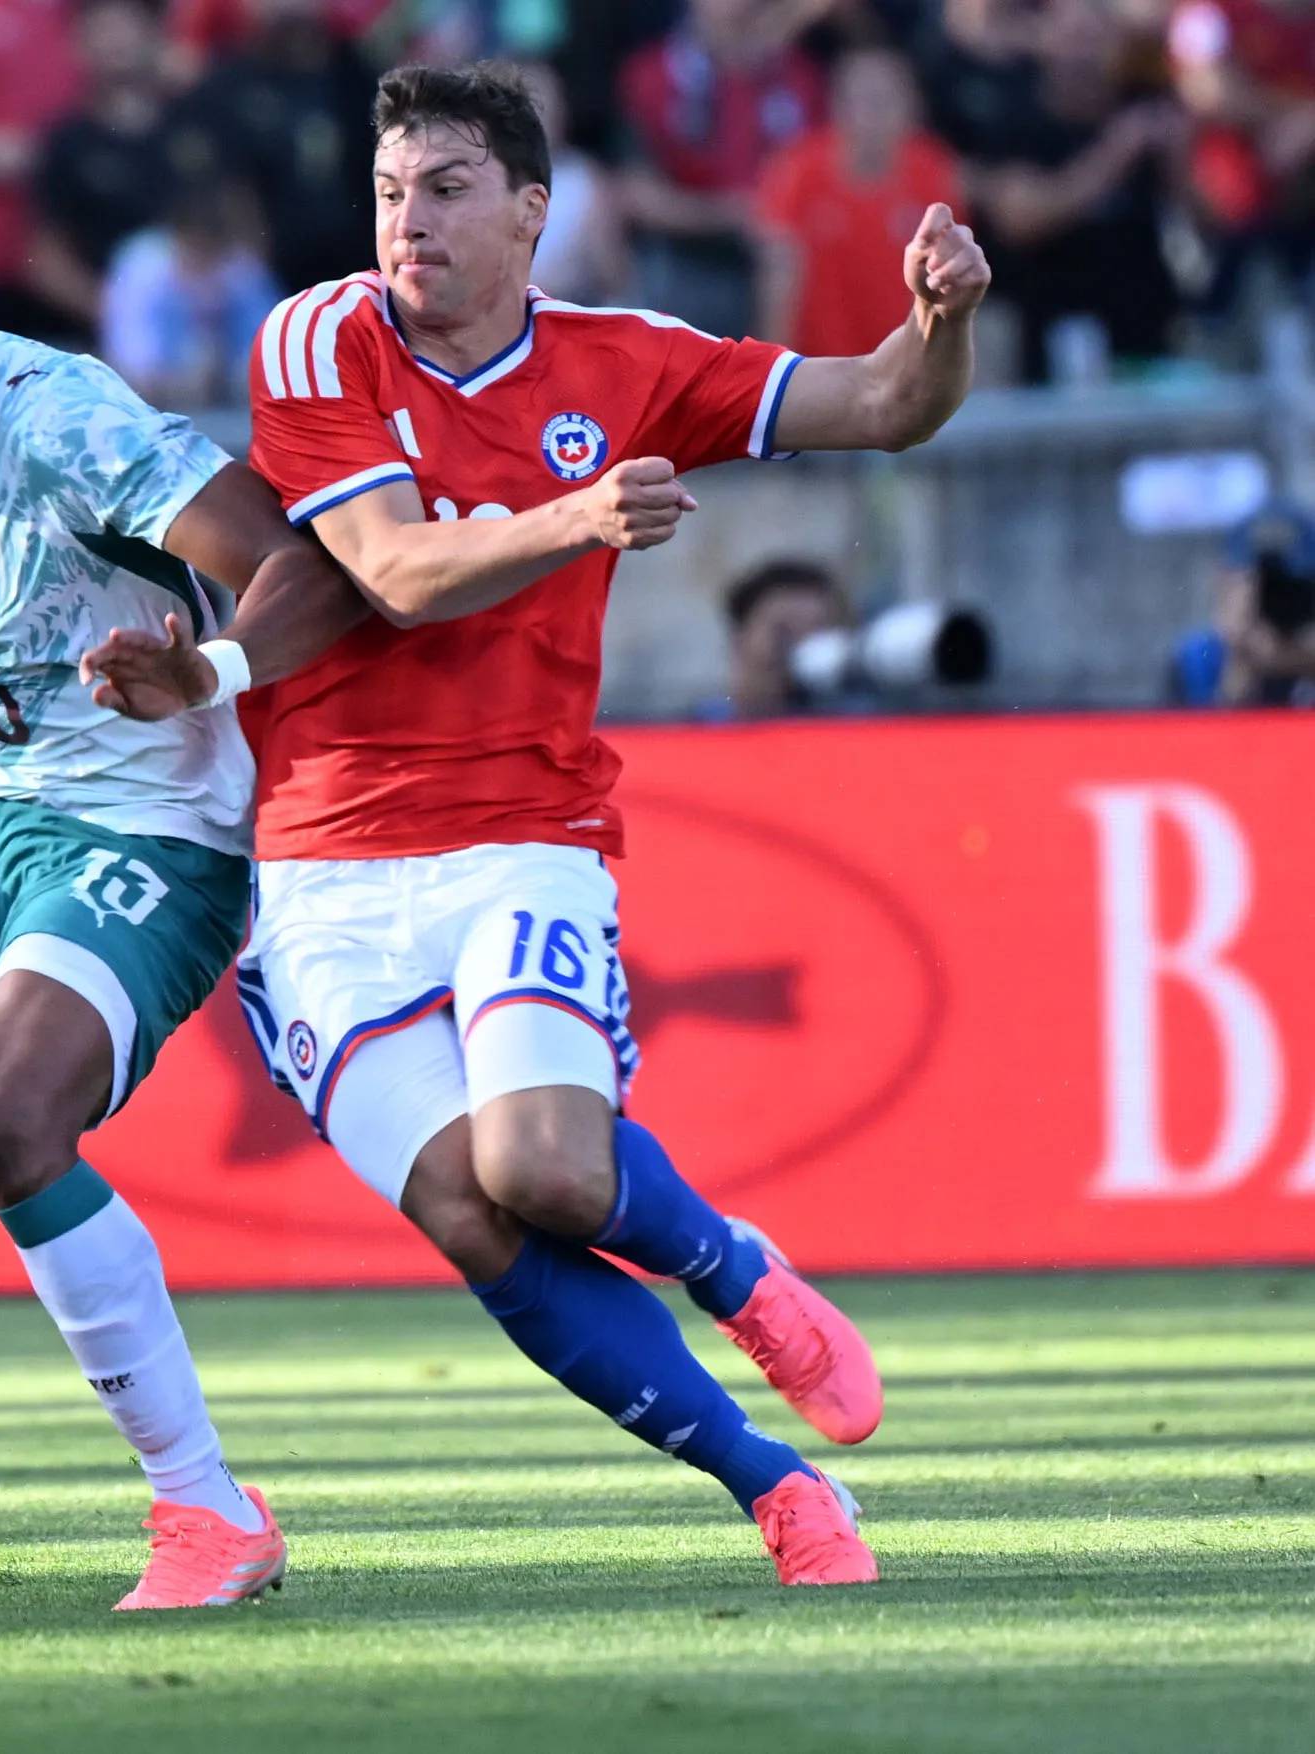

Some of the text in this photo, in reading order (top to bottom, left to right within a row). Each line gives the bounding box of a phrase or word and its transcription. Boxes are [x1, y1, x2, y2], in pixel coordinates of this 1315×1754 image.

[69, 847, 170, 928] 13
[508, 910, 590, 989] 16
[1067, 780, 1315, 1198] B
[614, 1385, 659, 1426] HILE
